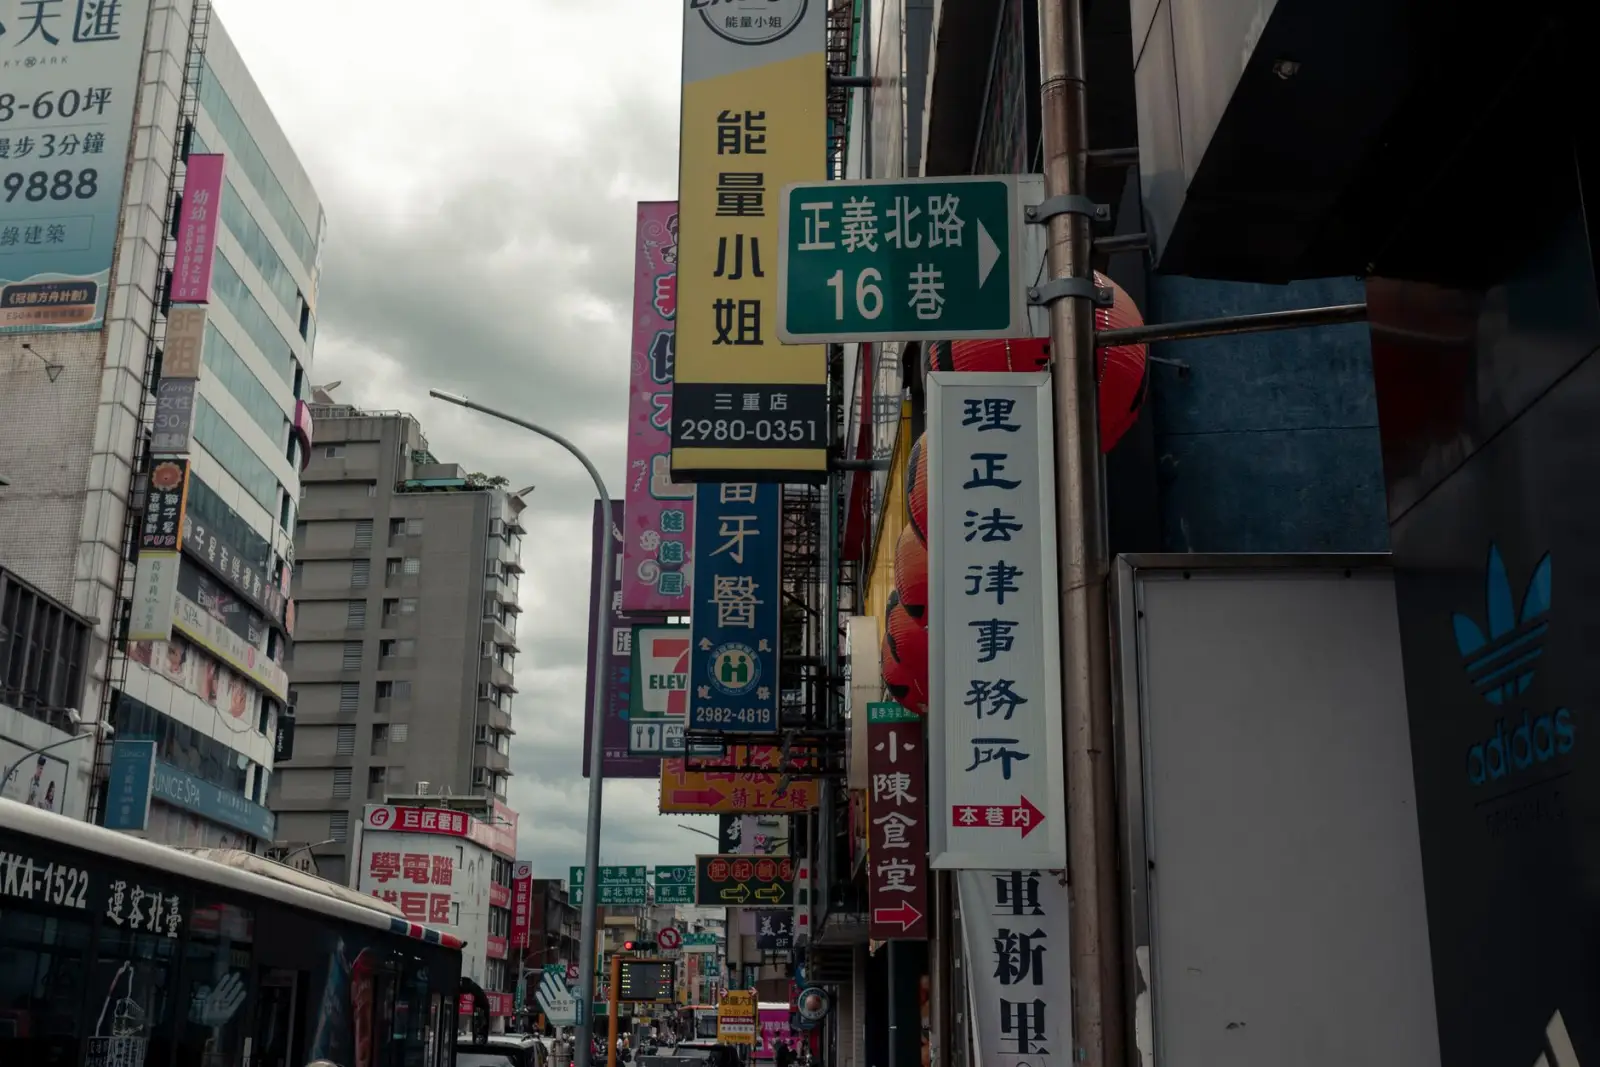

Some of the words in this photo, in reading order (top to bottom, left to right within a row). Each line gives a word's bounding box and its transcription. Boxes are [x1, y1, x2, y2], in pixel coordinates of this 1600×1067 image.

[0, 0, 122, 46] 天匯
[725, 15, 782, 28] 能量小姐
[4, 168, 98, 203] 9888
[1, 224, 66, 246] 綠建築
[712, 110, 767, 346] 能量小姐
[798, 193, 966, 254] 正義北路
[714, 393, 788, 411] 三重店
[680, 419, 817, 441] 2980-0351
[143, 534, 176, 546] PUB
[963, 398, 1030, 781] 理正法律事務所
[649, 674, 688, 690] ELEV
[696, 706, 771, 723] 2982-4819
[1466, 706, 1577, 788] adidas
[152, 772, 184, 800] UNICE
[402, 810, 463, 832] 巨匠電腦
[872, 731, 918, 893] 小陳食堂
[958, 807, 1031, 827] 本巷內
[370, 852, 454, 886] 學電腦
[991, 871, 1050, 1055] 重新里
